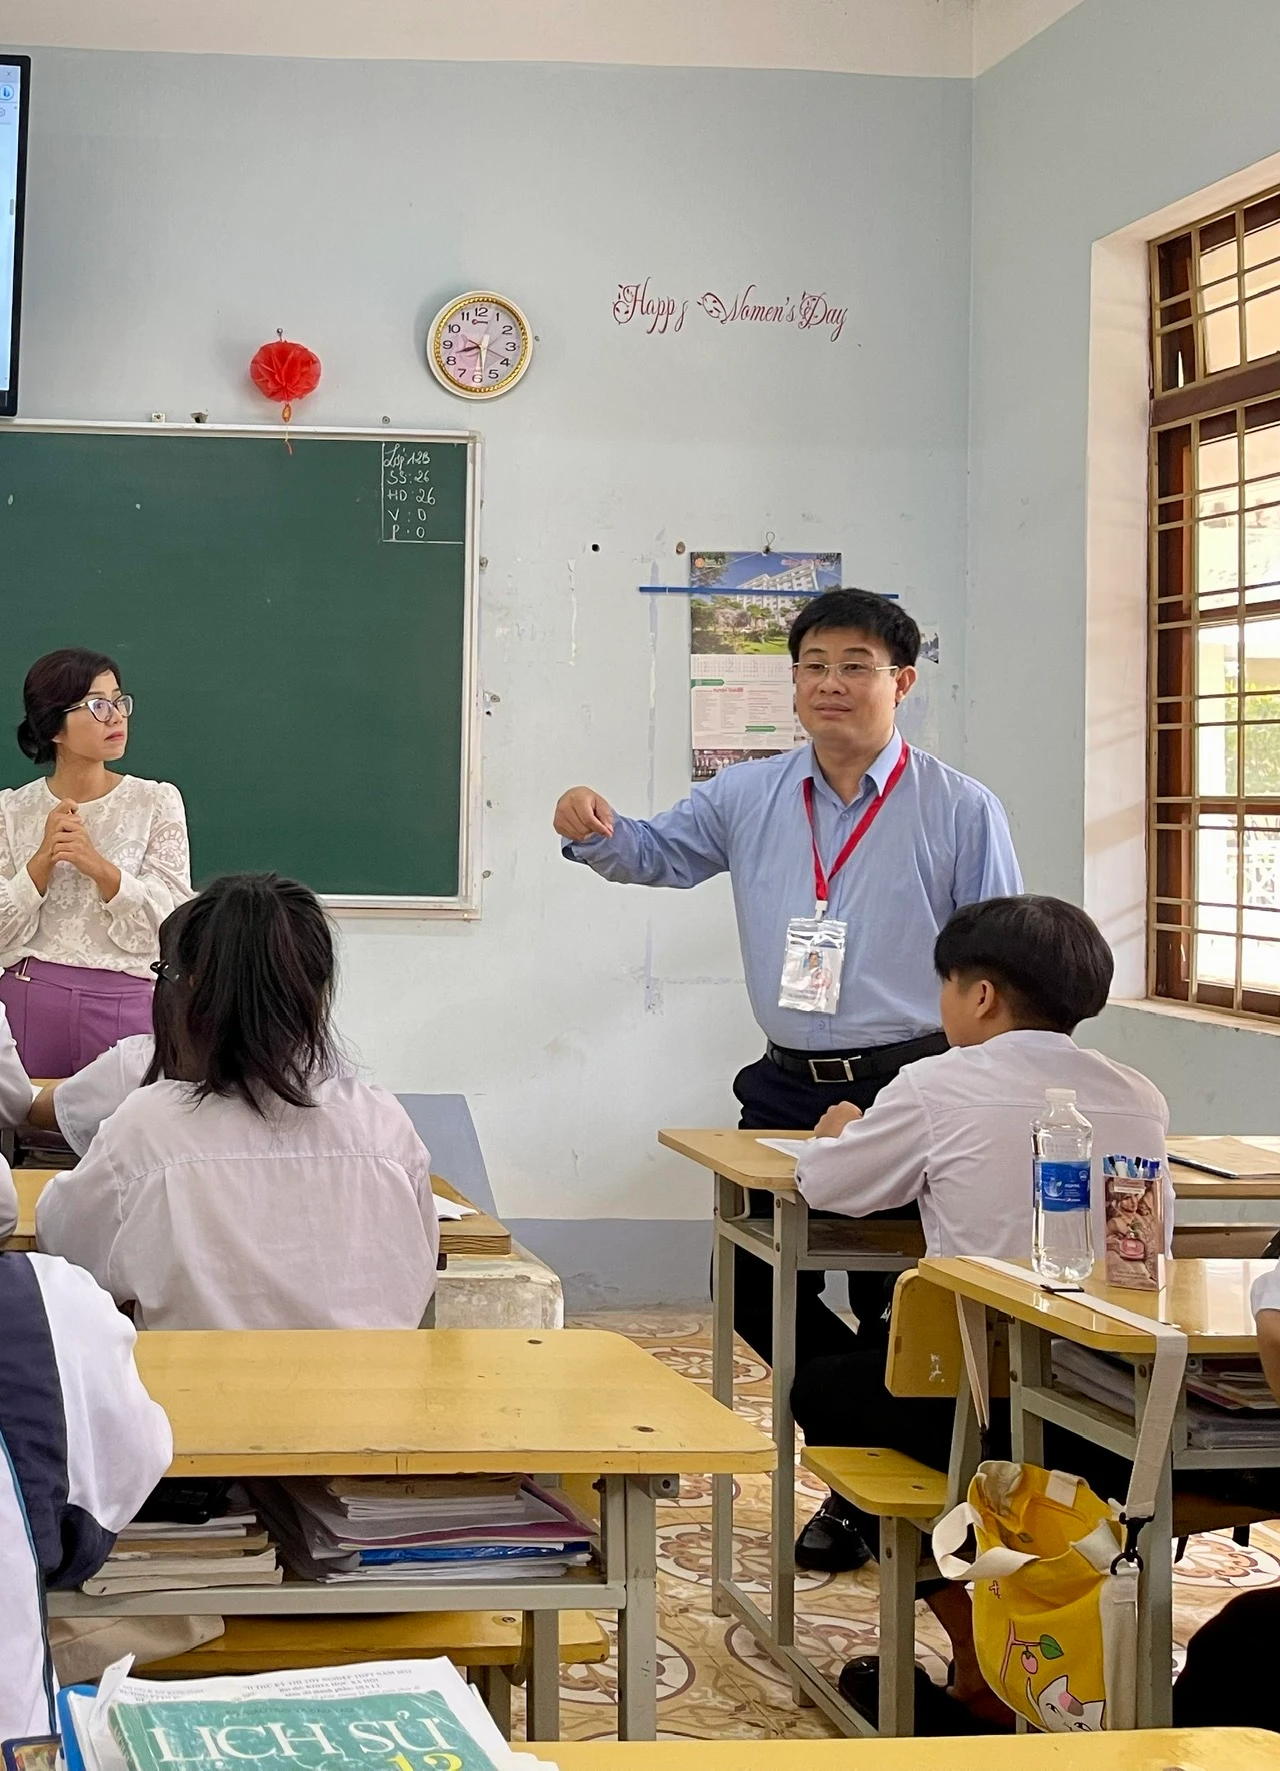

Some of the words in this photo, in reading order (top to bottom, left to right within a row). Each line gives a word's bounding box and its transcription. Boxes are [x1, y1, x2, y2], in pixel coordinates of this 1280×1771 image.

[474, 307, 488, 317] 12
[613, 276, 689, 334] Happy
[697, 284, 796, 325] Women's
[798, 290, 849, 342] Day
[461, 311, 470, 321] 11
[448, 323, 461, 334] 10
[501, 325, 513, 335] 2
[442, 340, 453, 350] 9
[505, 342, 517, 352] 3
[446, 356, 457, 366] 8
[500, 358, 510, 367] 4
[457, 368, 467, 378] 7
[472, 371, 483, 384] 6
[488, 369, 499, 379] 5
[414, 470, 430, 484] 26
[416, 487, 436, 505] 26
[147, 1721, 342, 1766] LỊCH
[348, 1710, 460, 1753] SỬ
